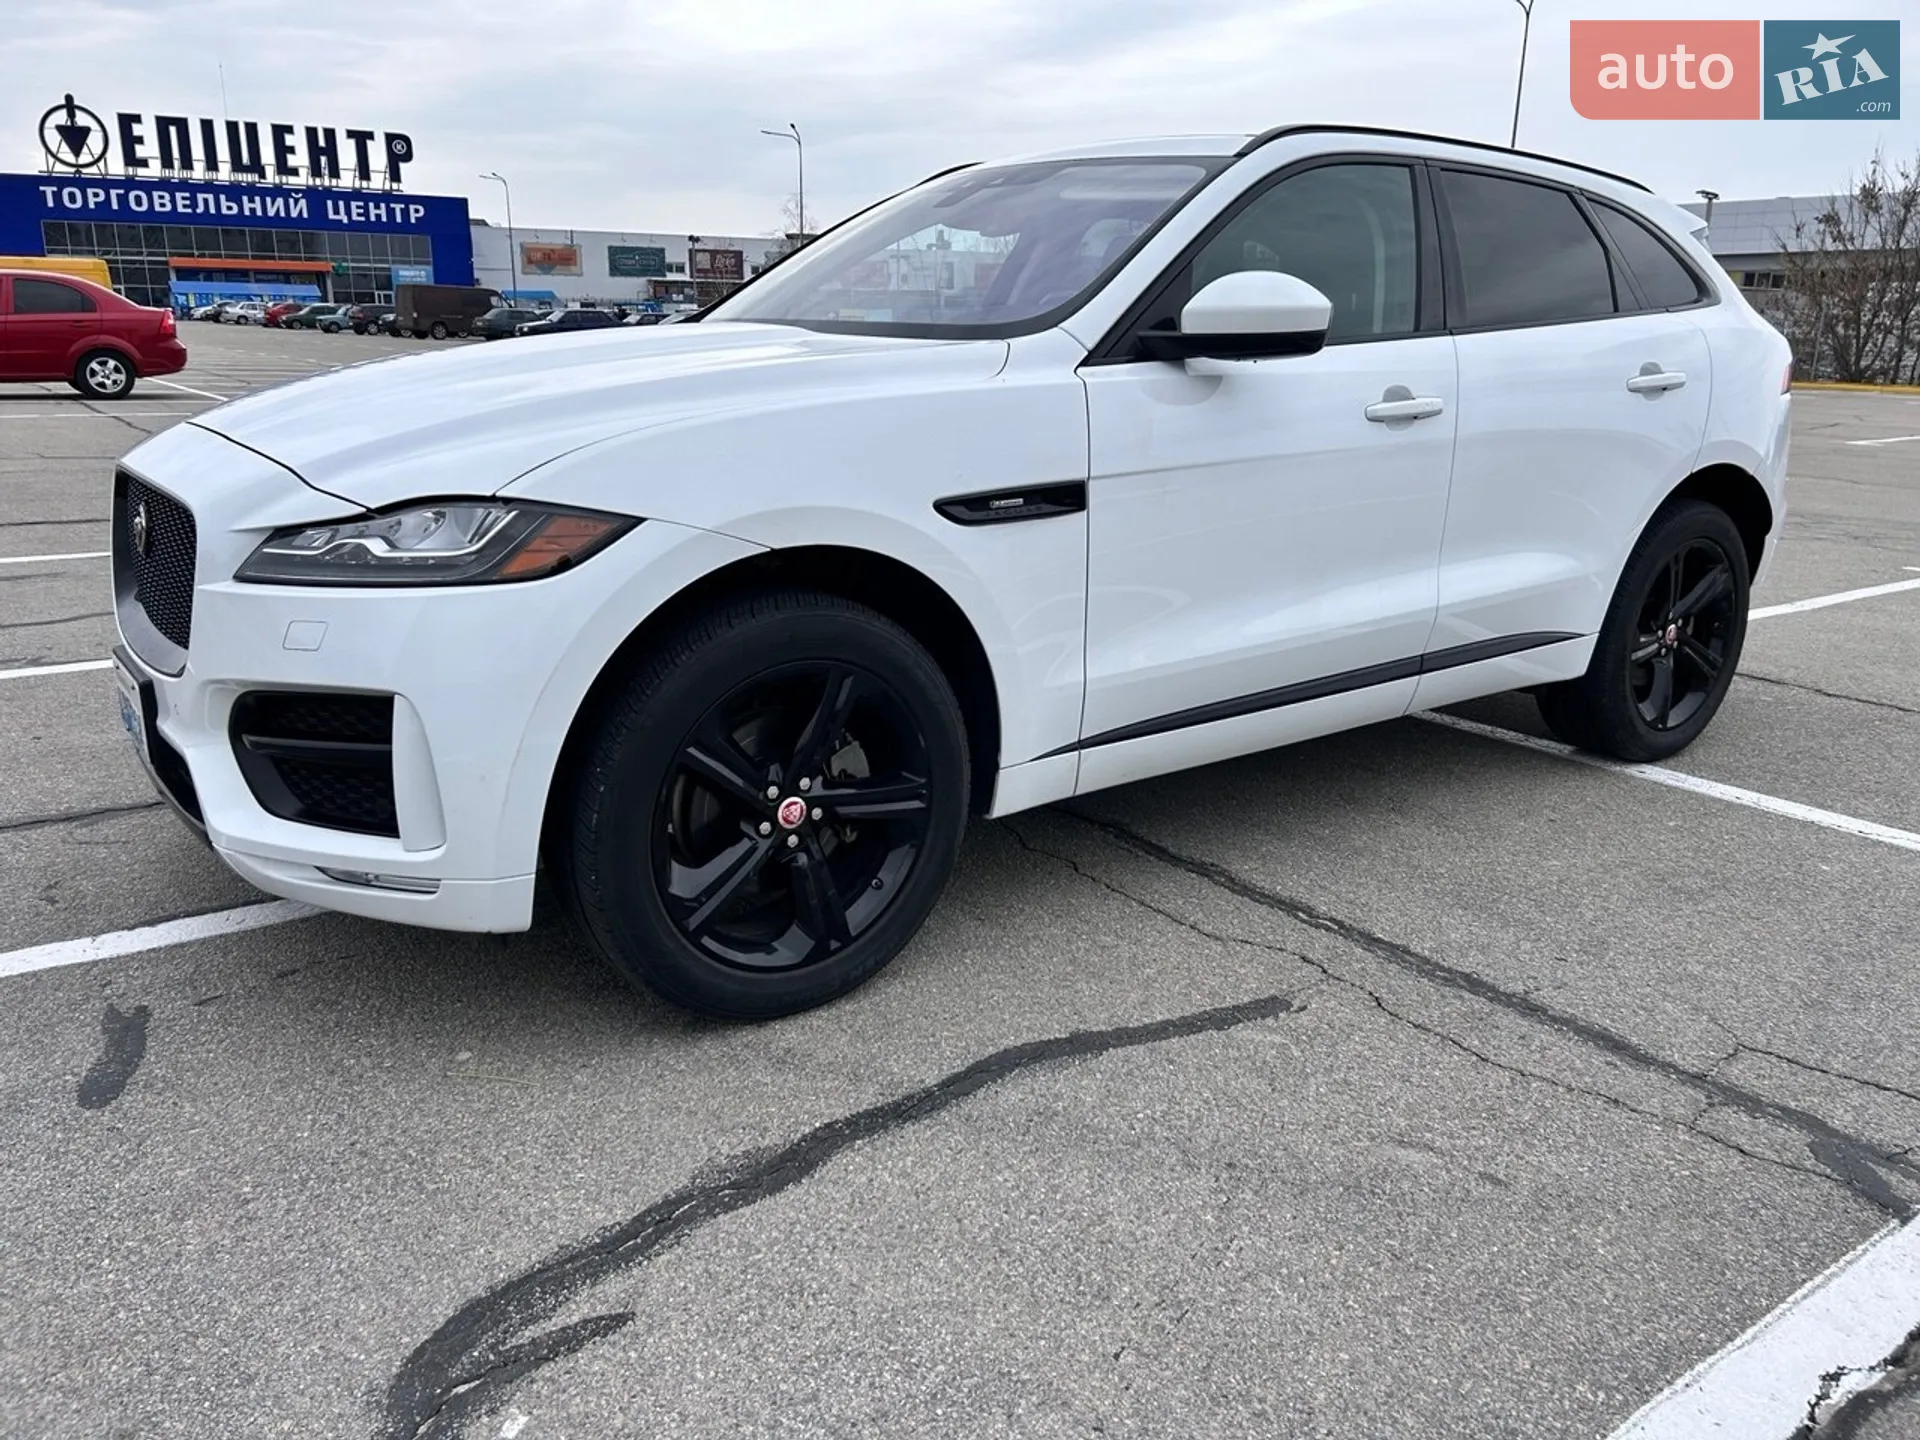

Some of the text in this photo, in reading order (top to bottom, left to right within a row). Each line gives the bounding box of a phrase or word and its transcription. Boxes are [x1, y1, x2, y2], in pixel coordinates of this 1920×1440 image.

[117, 113, 413, 183] ЕПІЦЕНТР
[40, 187, 425, 223] ТОРГОВЕЛЬНИЙ ЦЕНТР
